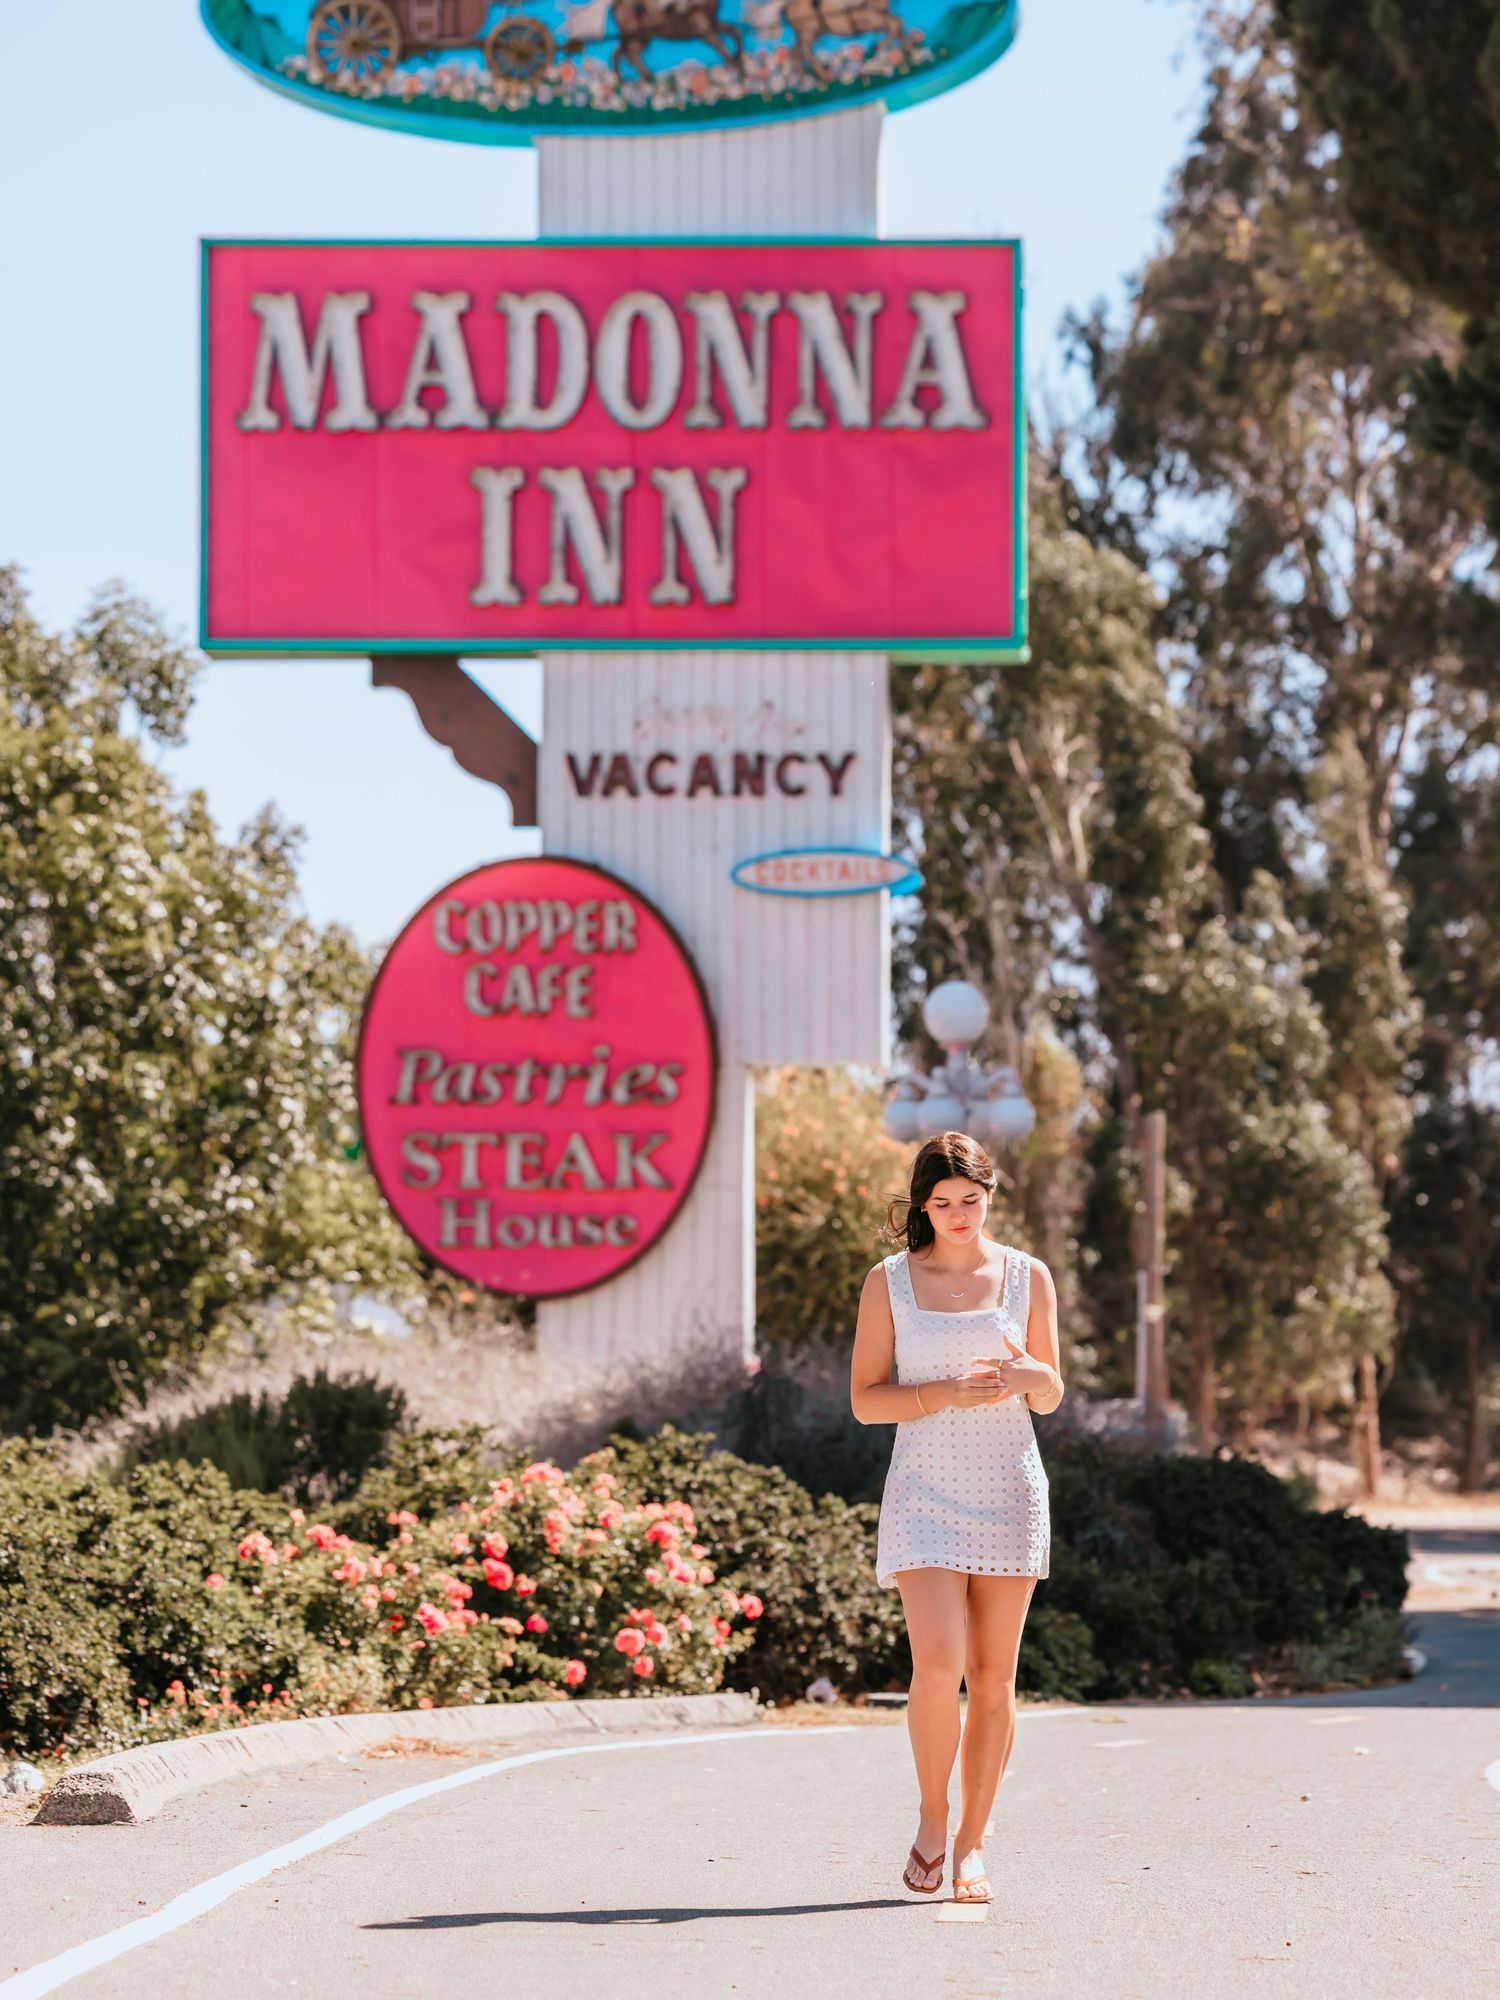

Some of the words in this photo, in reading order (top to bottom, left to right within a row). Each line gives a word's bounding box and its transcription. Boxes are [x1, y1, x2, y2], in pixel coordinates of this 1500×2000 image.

[236, 290, 989, 434] MADONNA
[468, 465, 749, 607] INN
[564, 751, 857, 798] VACANCY
[755, 857, 893, 885] COCKTAILS
[432, 897, 638, 955] COPPER
[464, 961, 596, 1019] CAFE
[388, 1045, 684, 1105] Pastries
[400, 1130, 673, 1191] STEAK
[435, 1196, 639, 1249] House
